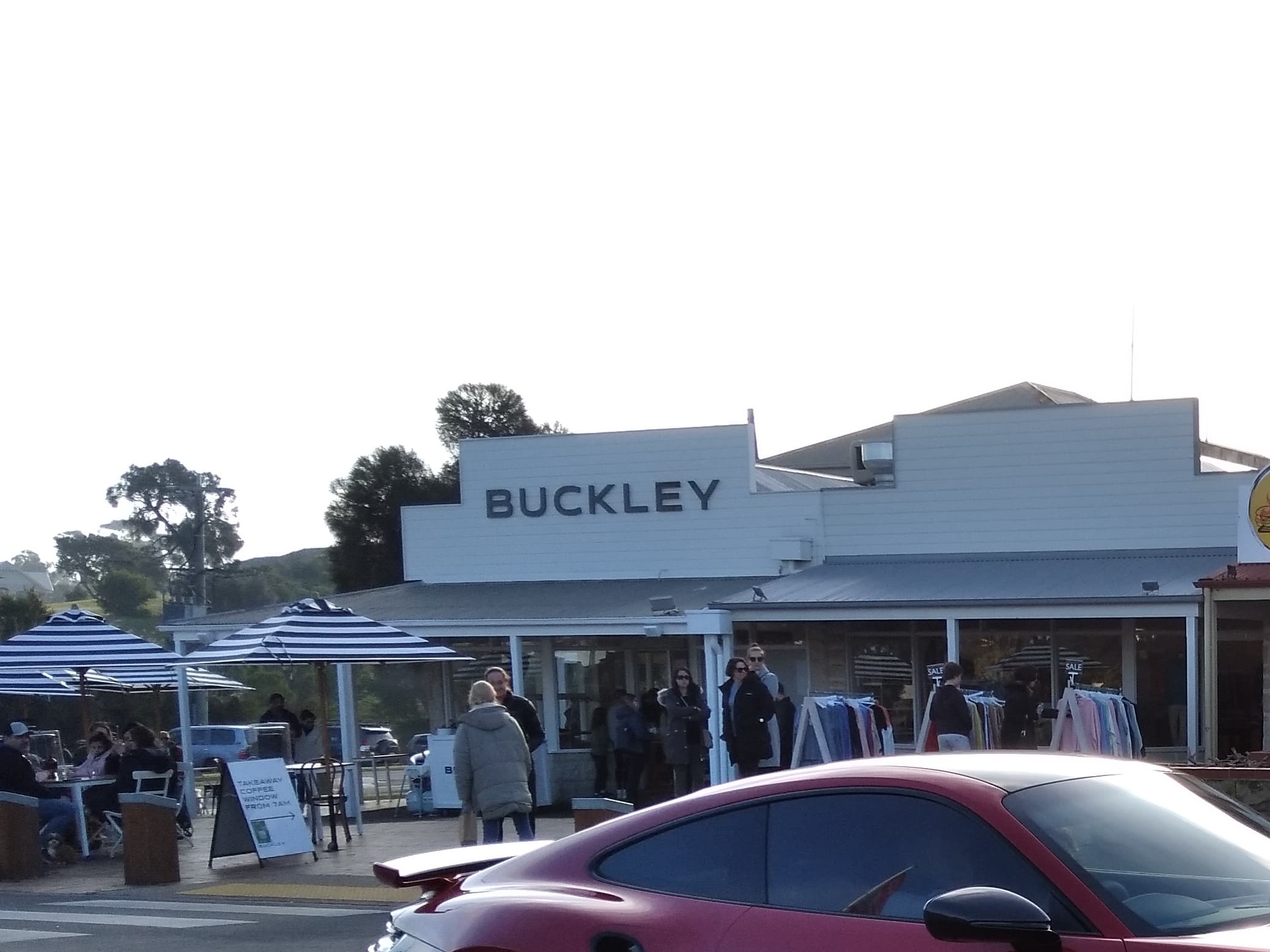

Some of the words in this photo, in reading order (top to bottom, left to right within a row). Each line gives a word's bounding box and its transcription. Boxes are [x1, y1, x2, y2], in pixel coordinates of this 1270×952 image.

[485, 479, 720, 519] BUCKLEY
[1065, 663, 1082, 671] SALE
[237, 777, 283, 786] TAKEAWAY
[240, 786, 275, 795] COFFEE
[243, 794, 278, 802] WINDOW
